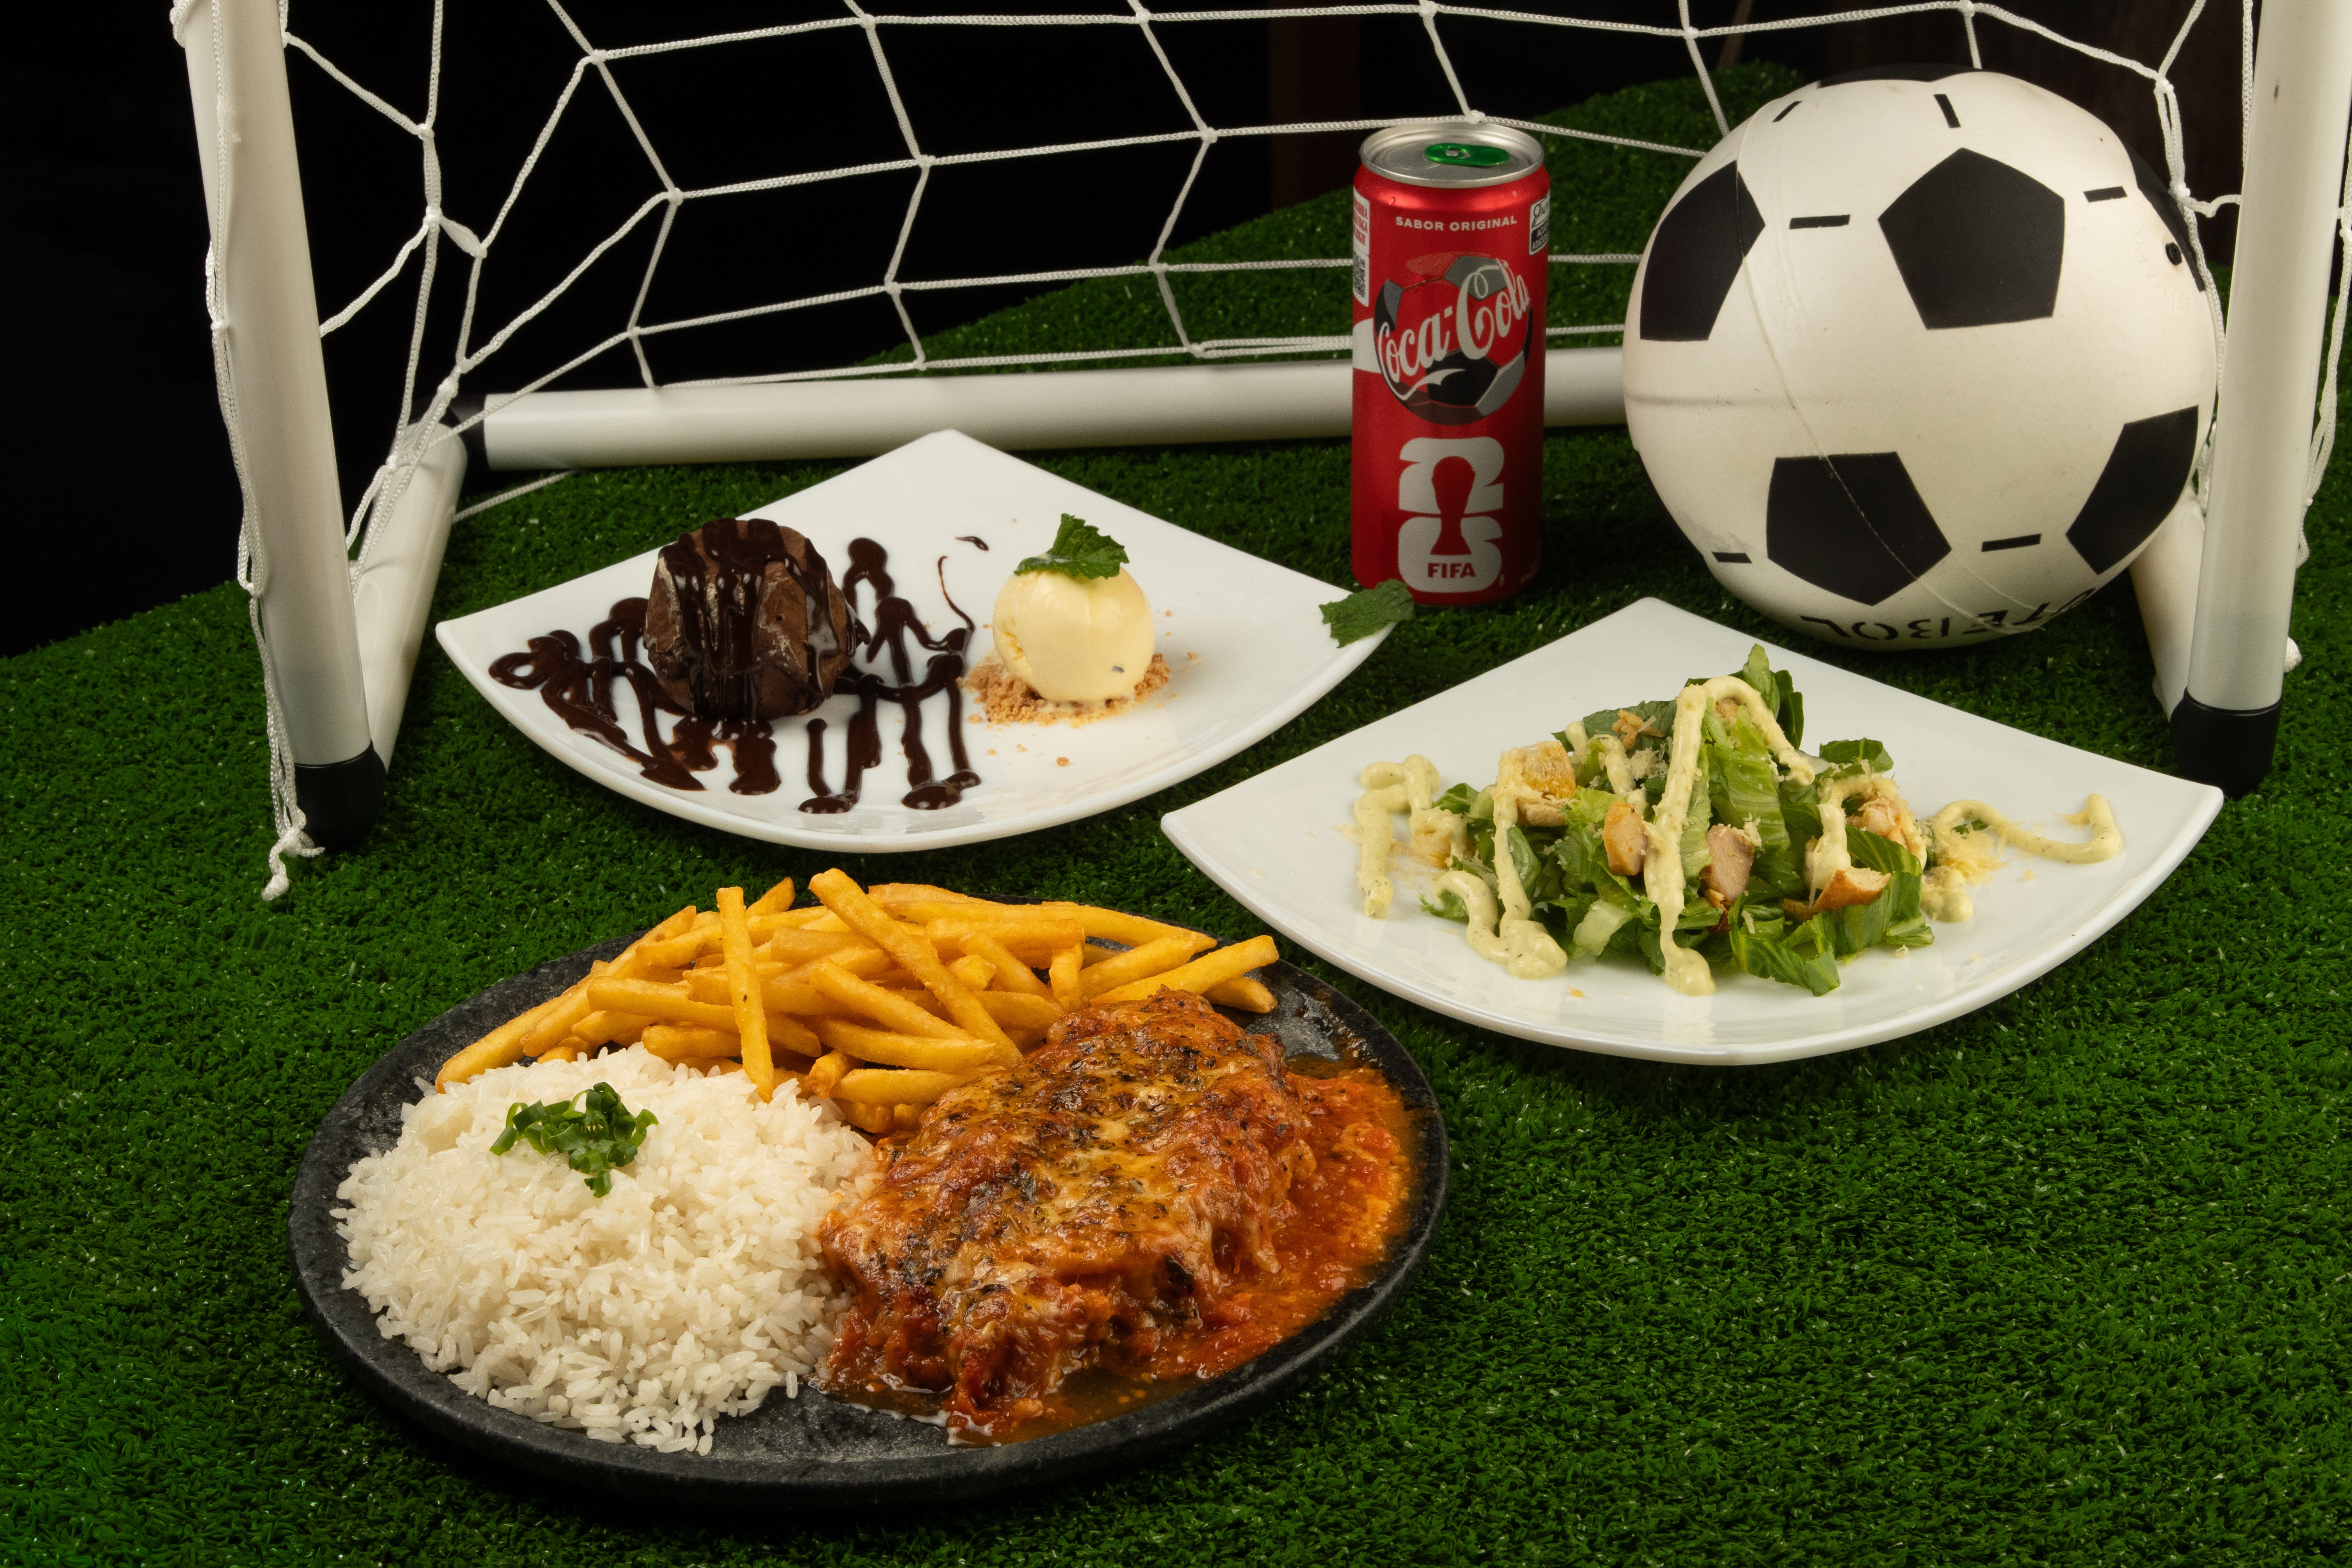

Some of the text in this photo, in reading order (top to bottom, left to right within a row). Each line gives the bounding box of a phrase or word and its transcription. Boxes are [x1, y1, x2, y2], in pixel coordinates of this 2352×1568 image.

[1396, 215, 1517, 232] SABOR ORIGINAL
[1378, 258, 1531, 400] Coca-Cola
[1427, 562, 1476, 578] FIFA
[1799, 586, 2097, 640] UTEBOL
